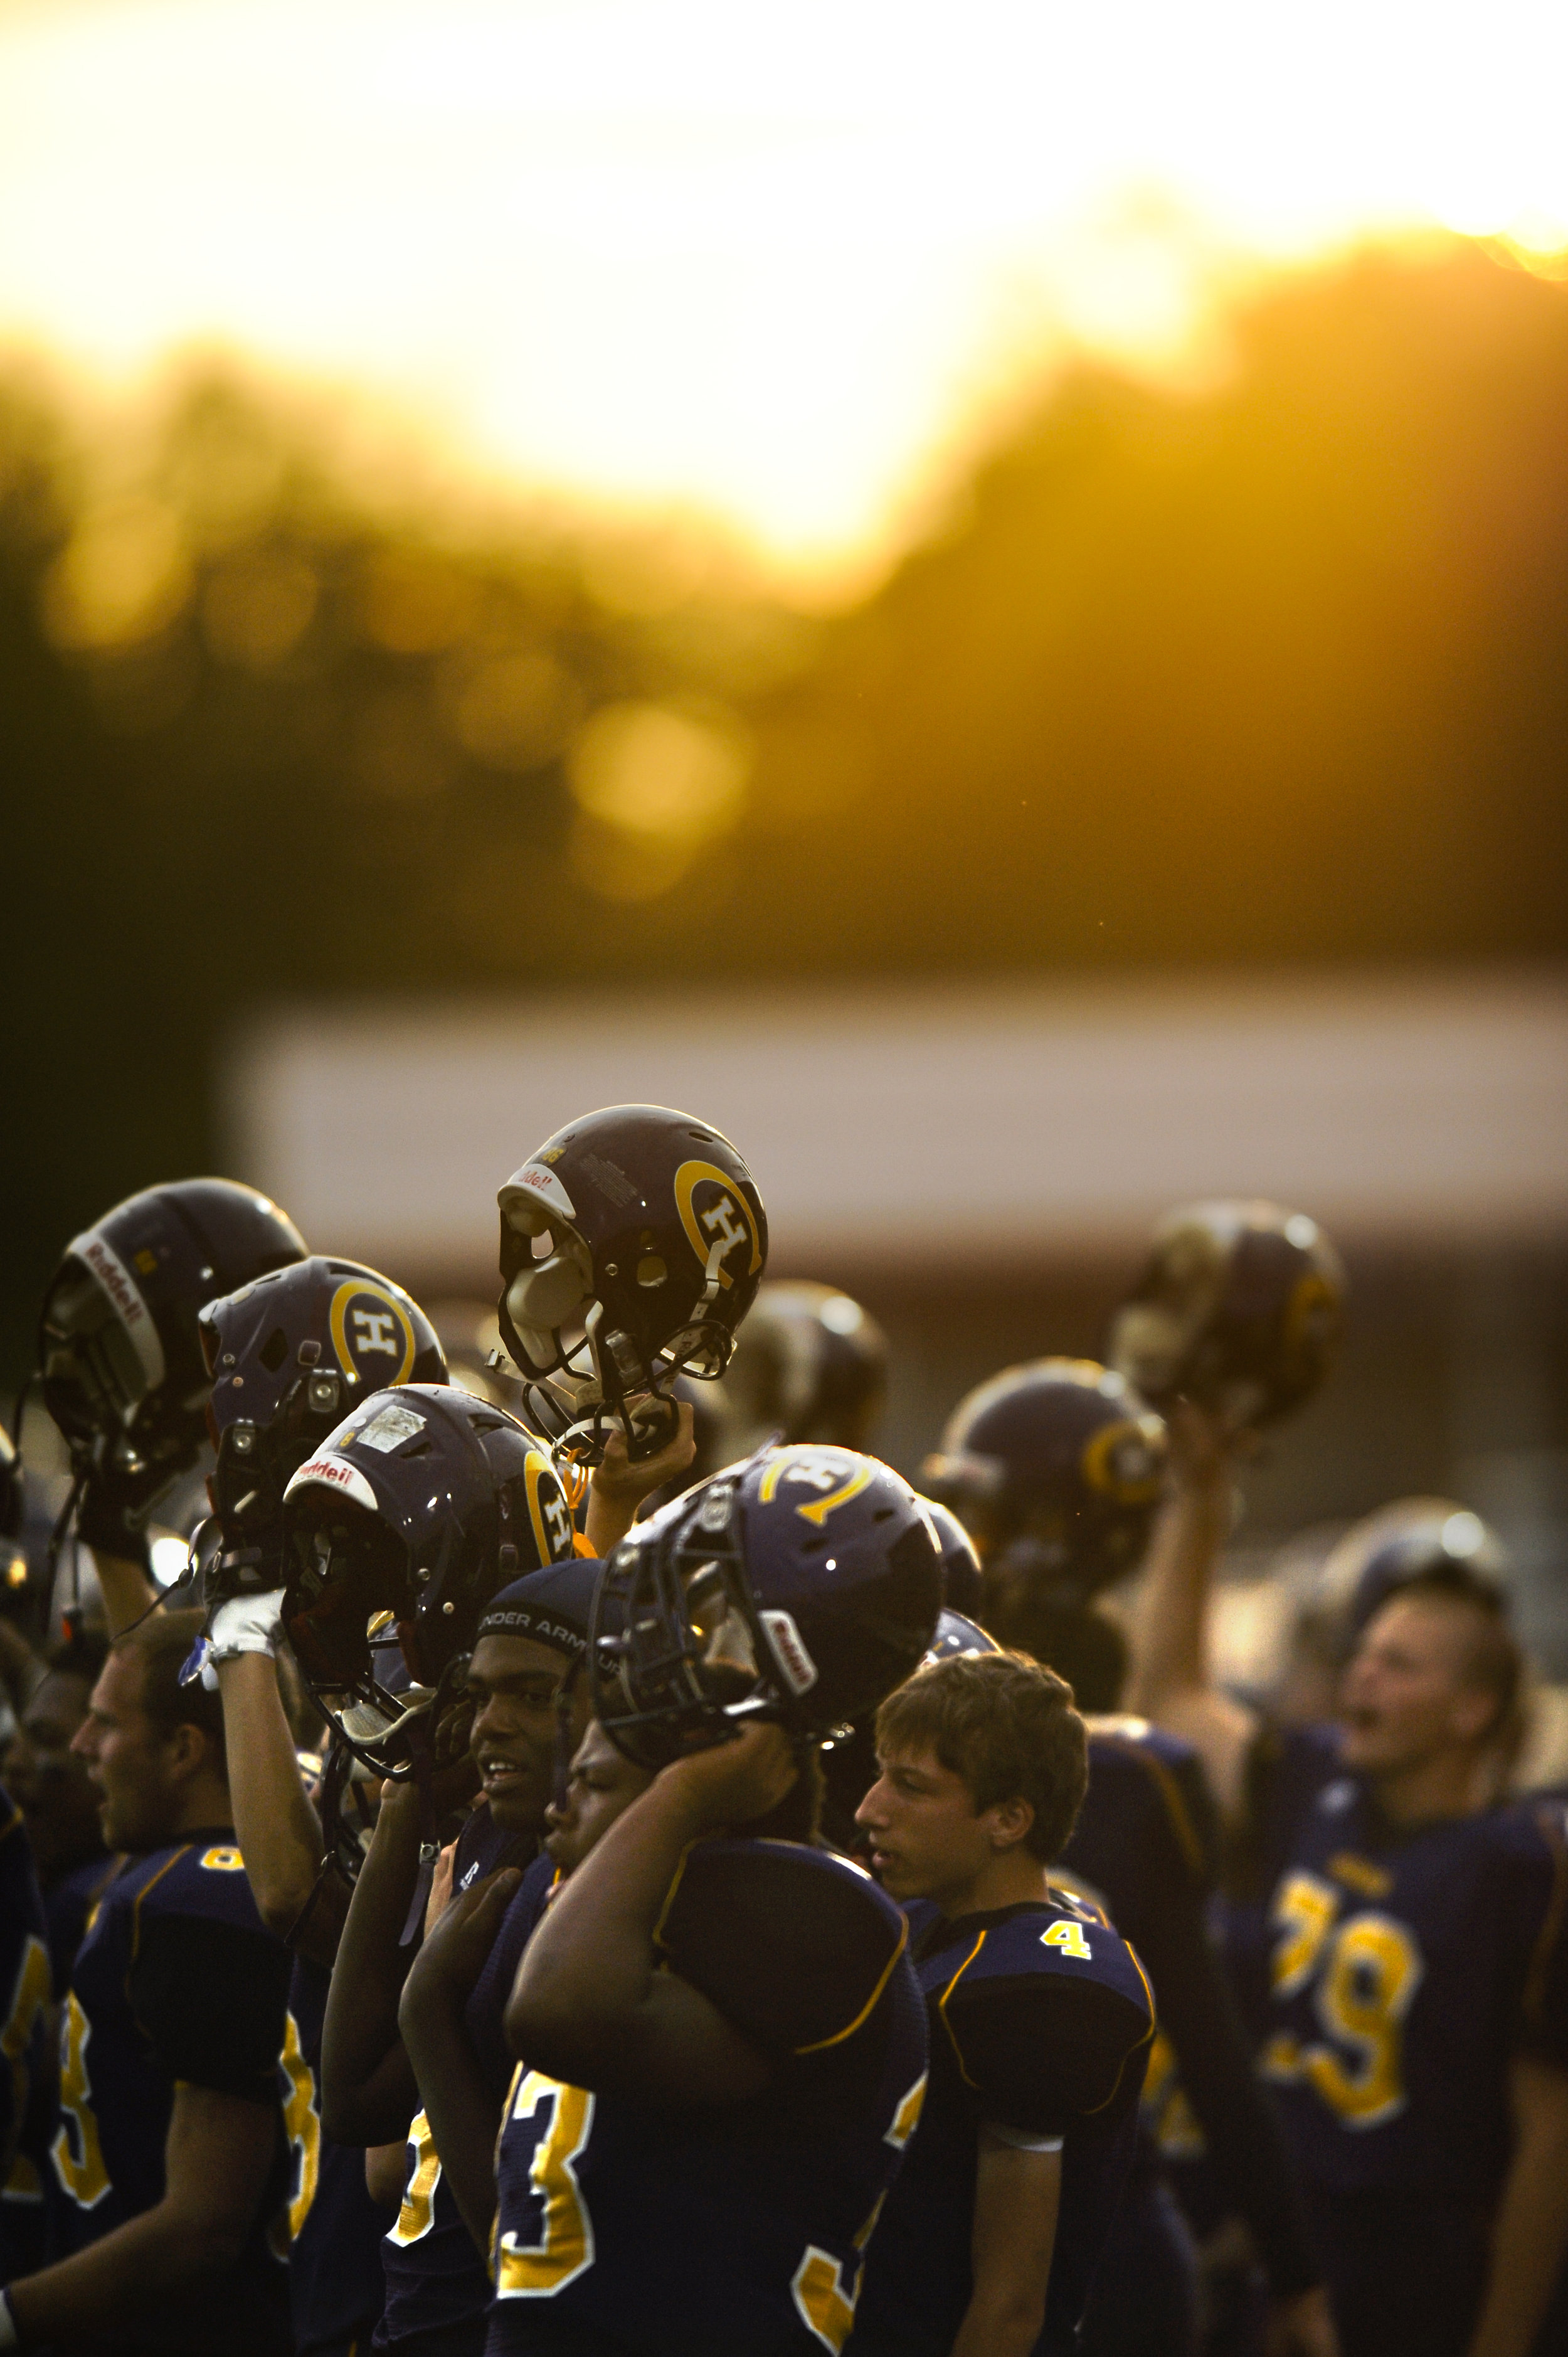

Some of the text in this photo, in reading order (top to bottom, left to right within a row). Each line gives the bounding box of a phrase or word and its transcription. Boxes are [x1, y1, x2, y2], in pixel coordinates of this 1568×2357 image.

[701, 1195, 748, 1258] H
[352, 1309, 398, 1356] H
[1039, 1920, 1092, 1961] 4
